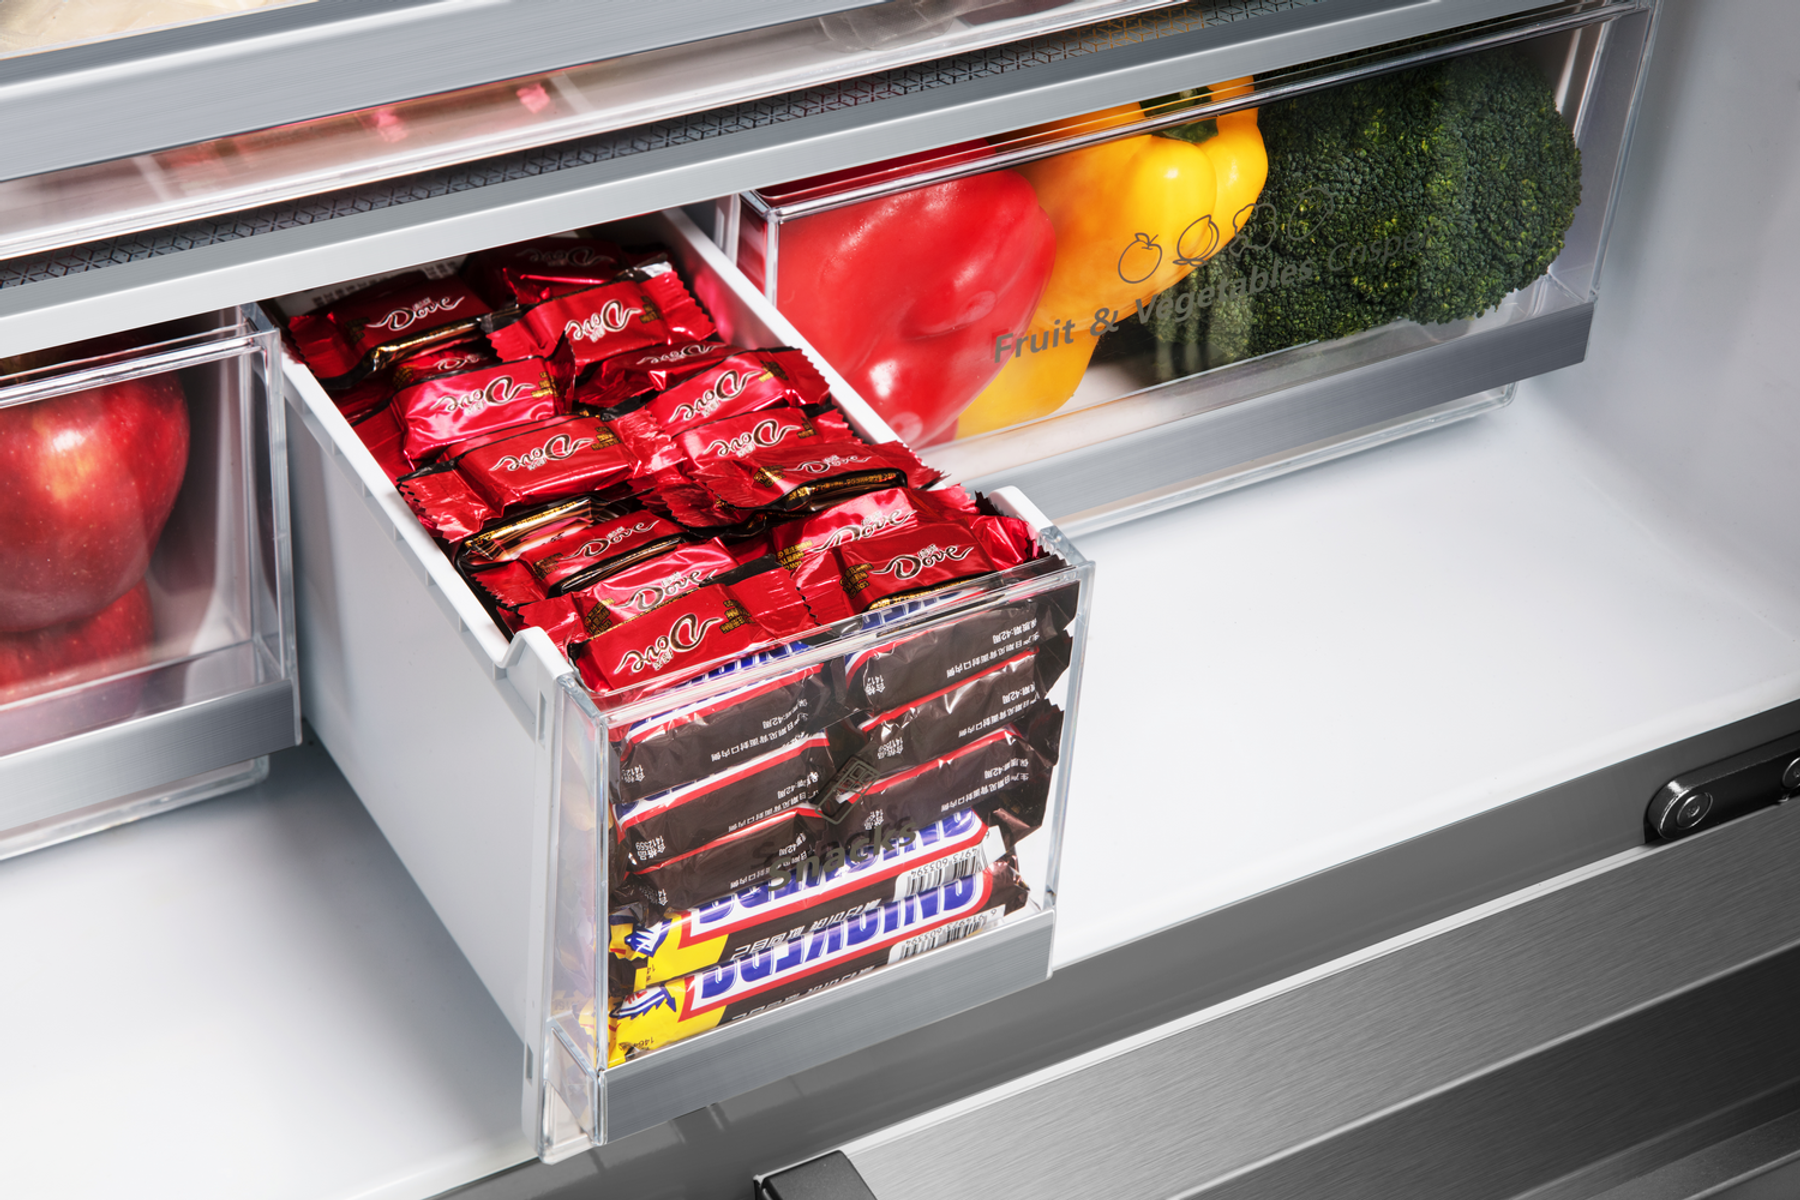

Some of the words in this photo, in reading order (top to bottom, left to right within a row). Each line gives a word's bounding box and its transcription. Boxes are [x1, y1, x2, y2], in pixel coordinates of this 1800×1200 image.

[366, 295, 466, 330] Dove
[993, 319, 1076, 363] Fruit
[1089, 307, 1120, 338] &
[1134, 256, 1313, 325] Vegetables
[1328, 227, 1434, 271] Crisper
[564, 299, 643, 341] Dove
[430, 375, 535, 413] Dove
[669, 369, 763, 423] Dove
[488, 434, 596, 472] Dove
[702, 420, 802, 457] Dove
[560, 520, 661, 560] Dove
[811, 510, 918, 552] Dove
[870, 544, 974, 580] Dove
[612, 567, 718, 612] Dove
[614, 614, 724, 674] Dove
[637, 842, 666, 861] 合格品
[767, 820, 917, 892] Snacks
